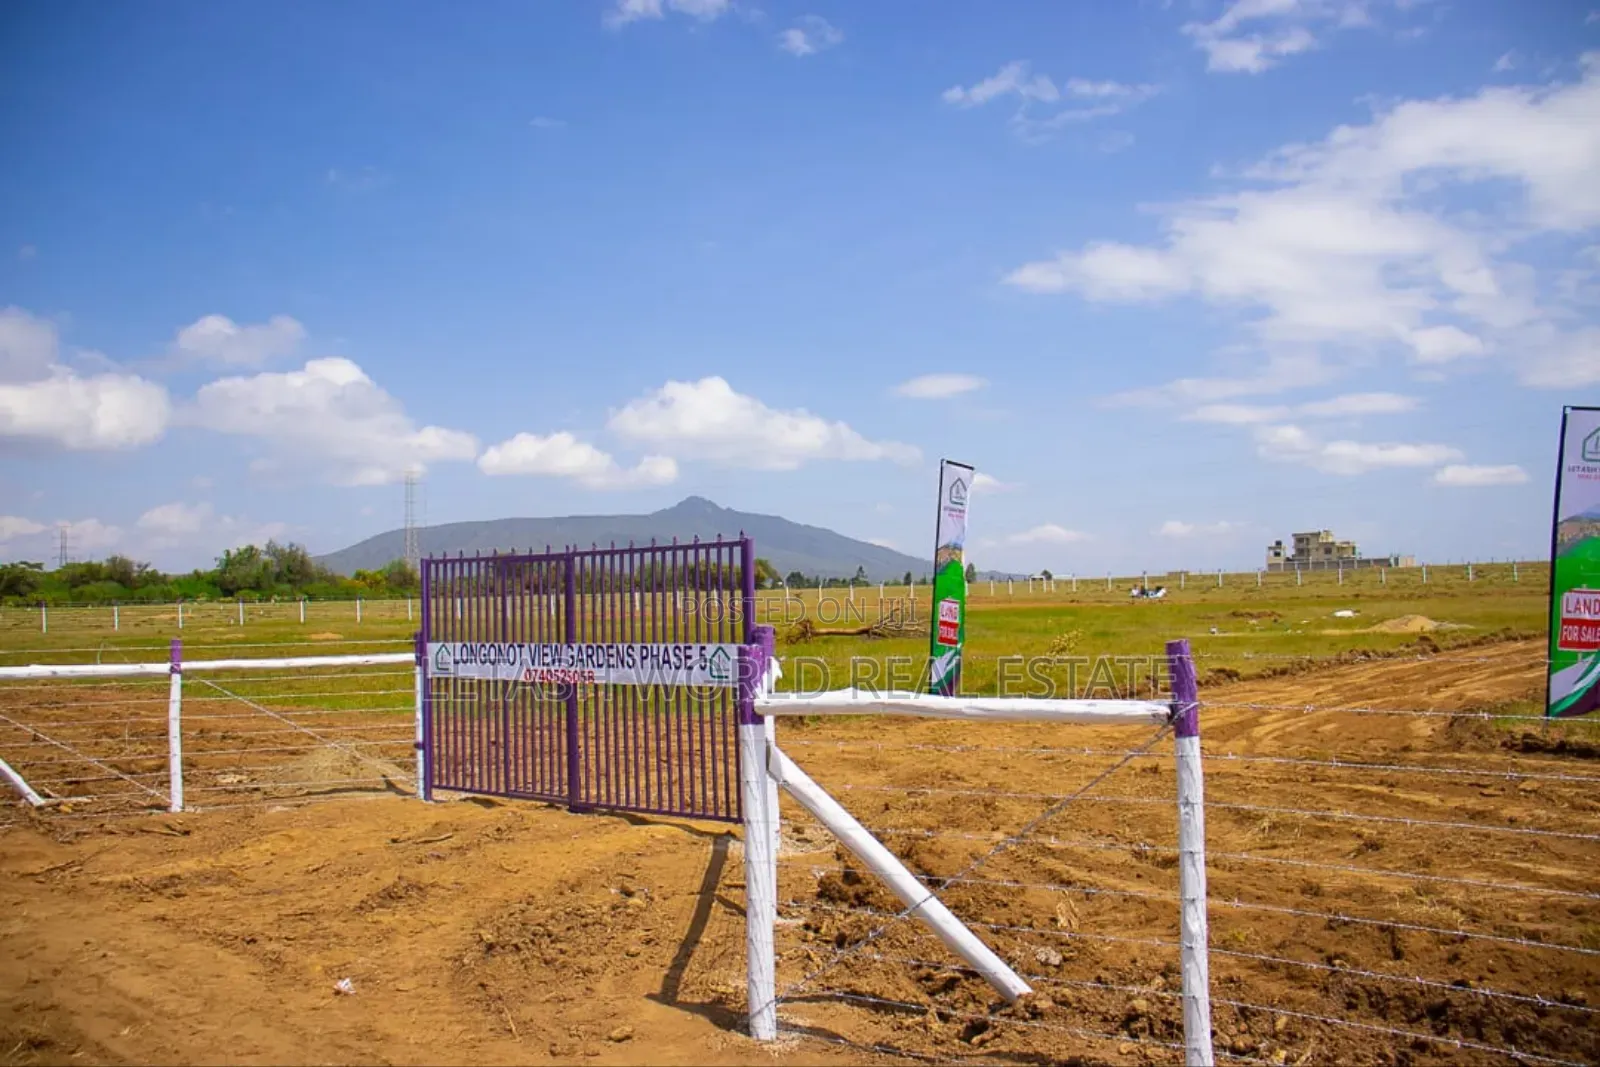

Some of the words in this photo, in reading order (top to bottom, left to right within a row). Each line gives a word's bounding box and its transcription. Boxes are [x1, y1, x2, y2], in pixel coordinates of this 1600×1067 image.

[1565, 595, 1600, 616] LAND
[1562, 624, 1579, 641] FOR
[1581, 626, 1600, 642] SALE
[452, 643, 524, 666] LONGONOT
[528, 644, 562, 667] VIEW
[567, 645, 635, 669] GARDENS
[640, 645, 694, 671] PHASE
[699, 646, 707, 670] 5
